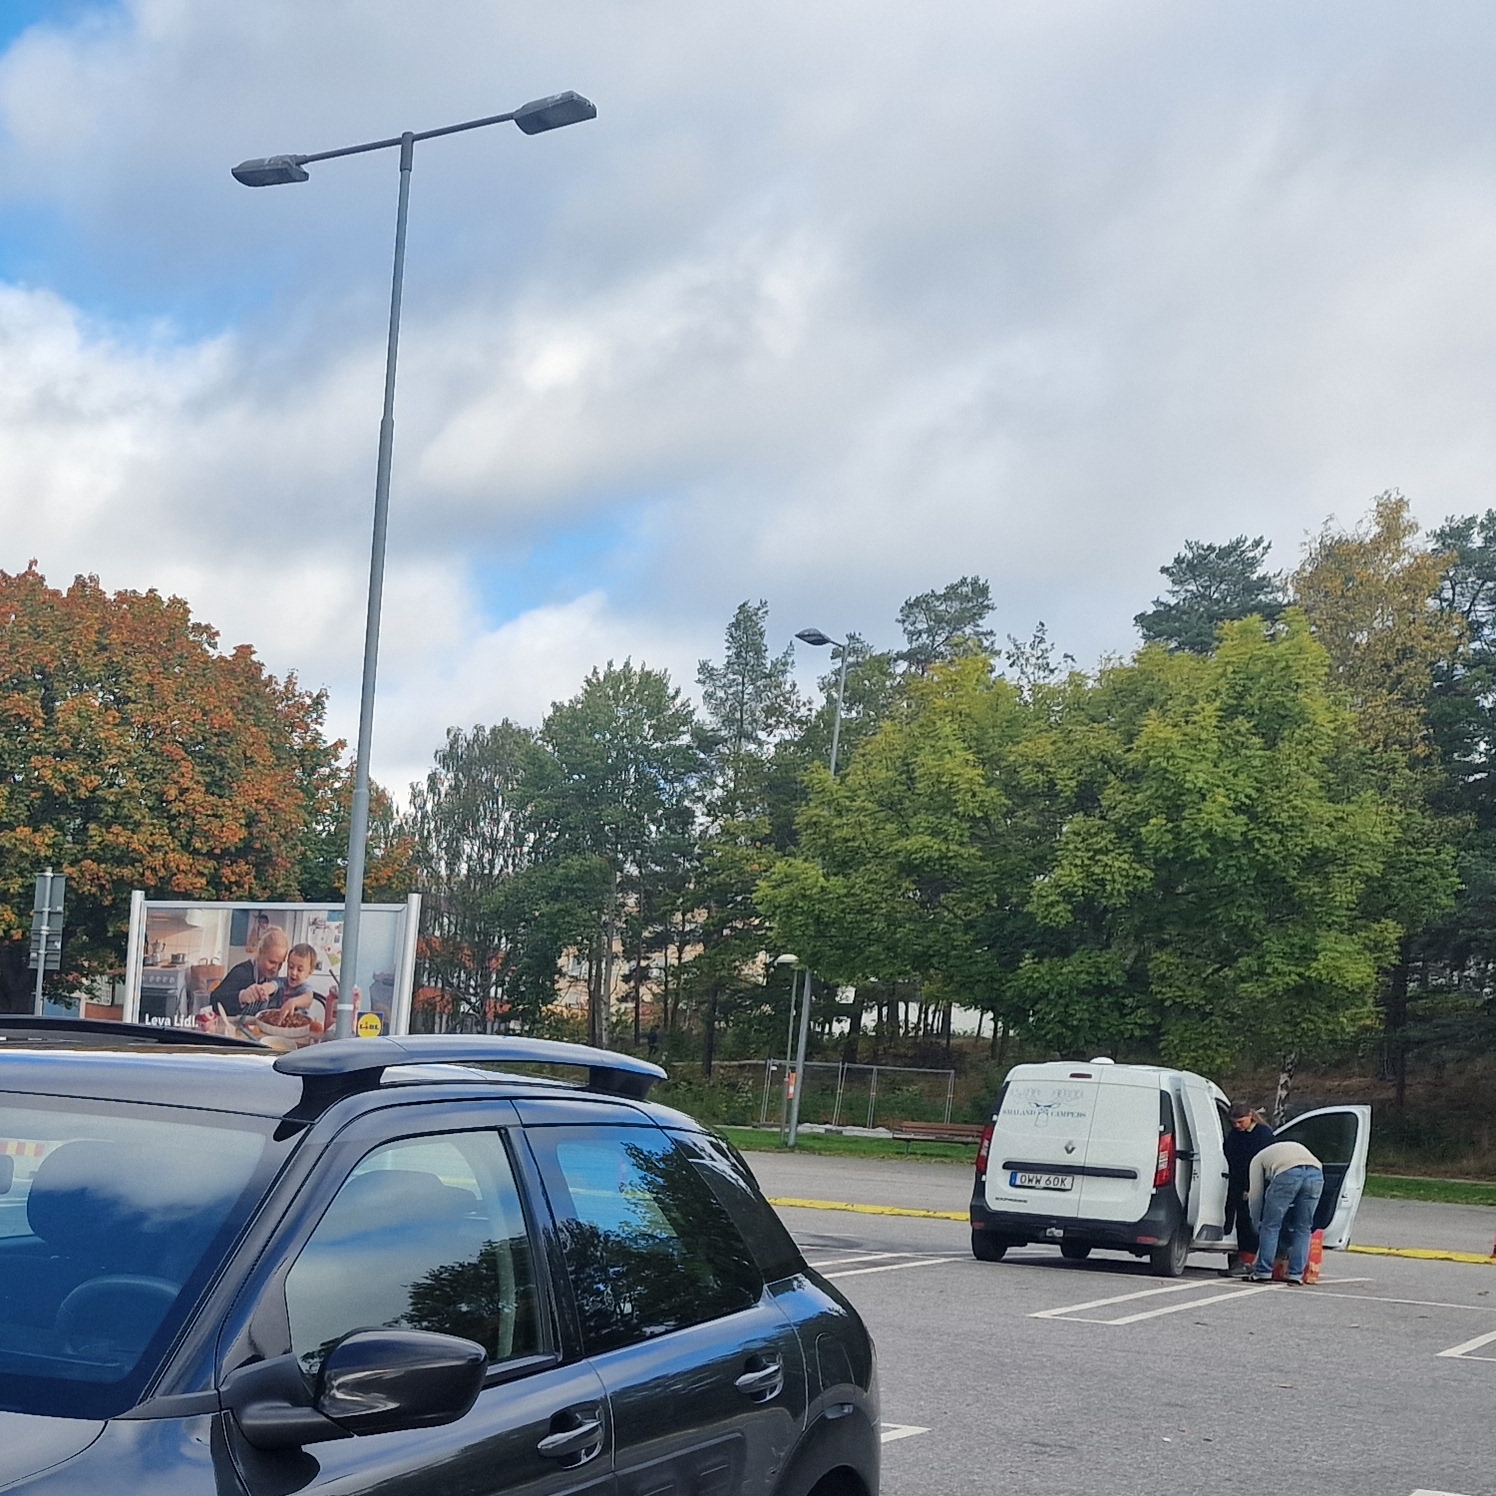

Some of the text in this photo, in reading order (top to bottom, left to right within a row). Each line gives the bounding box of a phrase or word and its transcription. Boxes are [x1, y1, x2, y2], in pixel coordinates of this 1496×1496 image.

[145, 1013, 172, 1027] Leva
[1051, 1110, 1087, 1118] CAMPERS
[1020, 1174, 1068, 1188] OWW 60K
